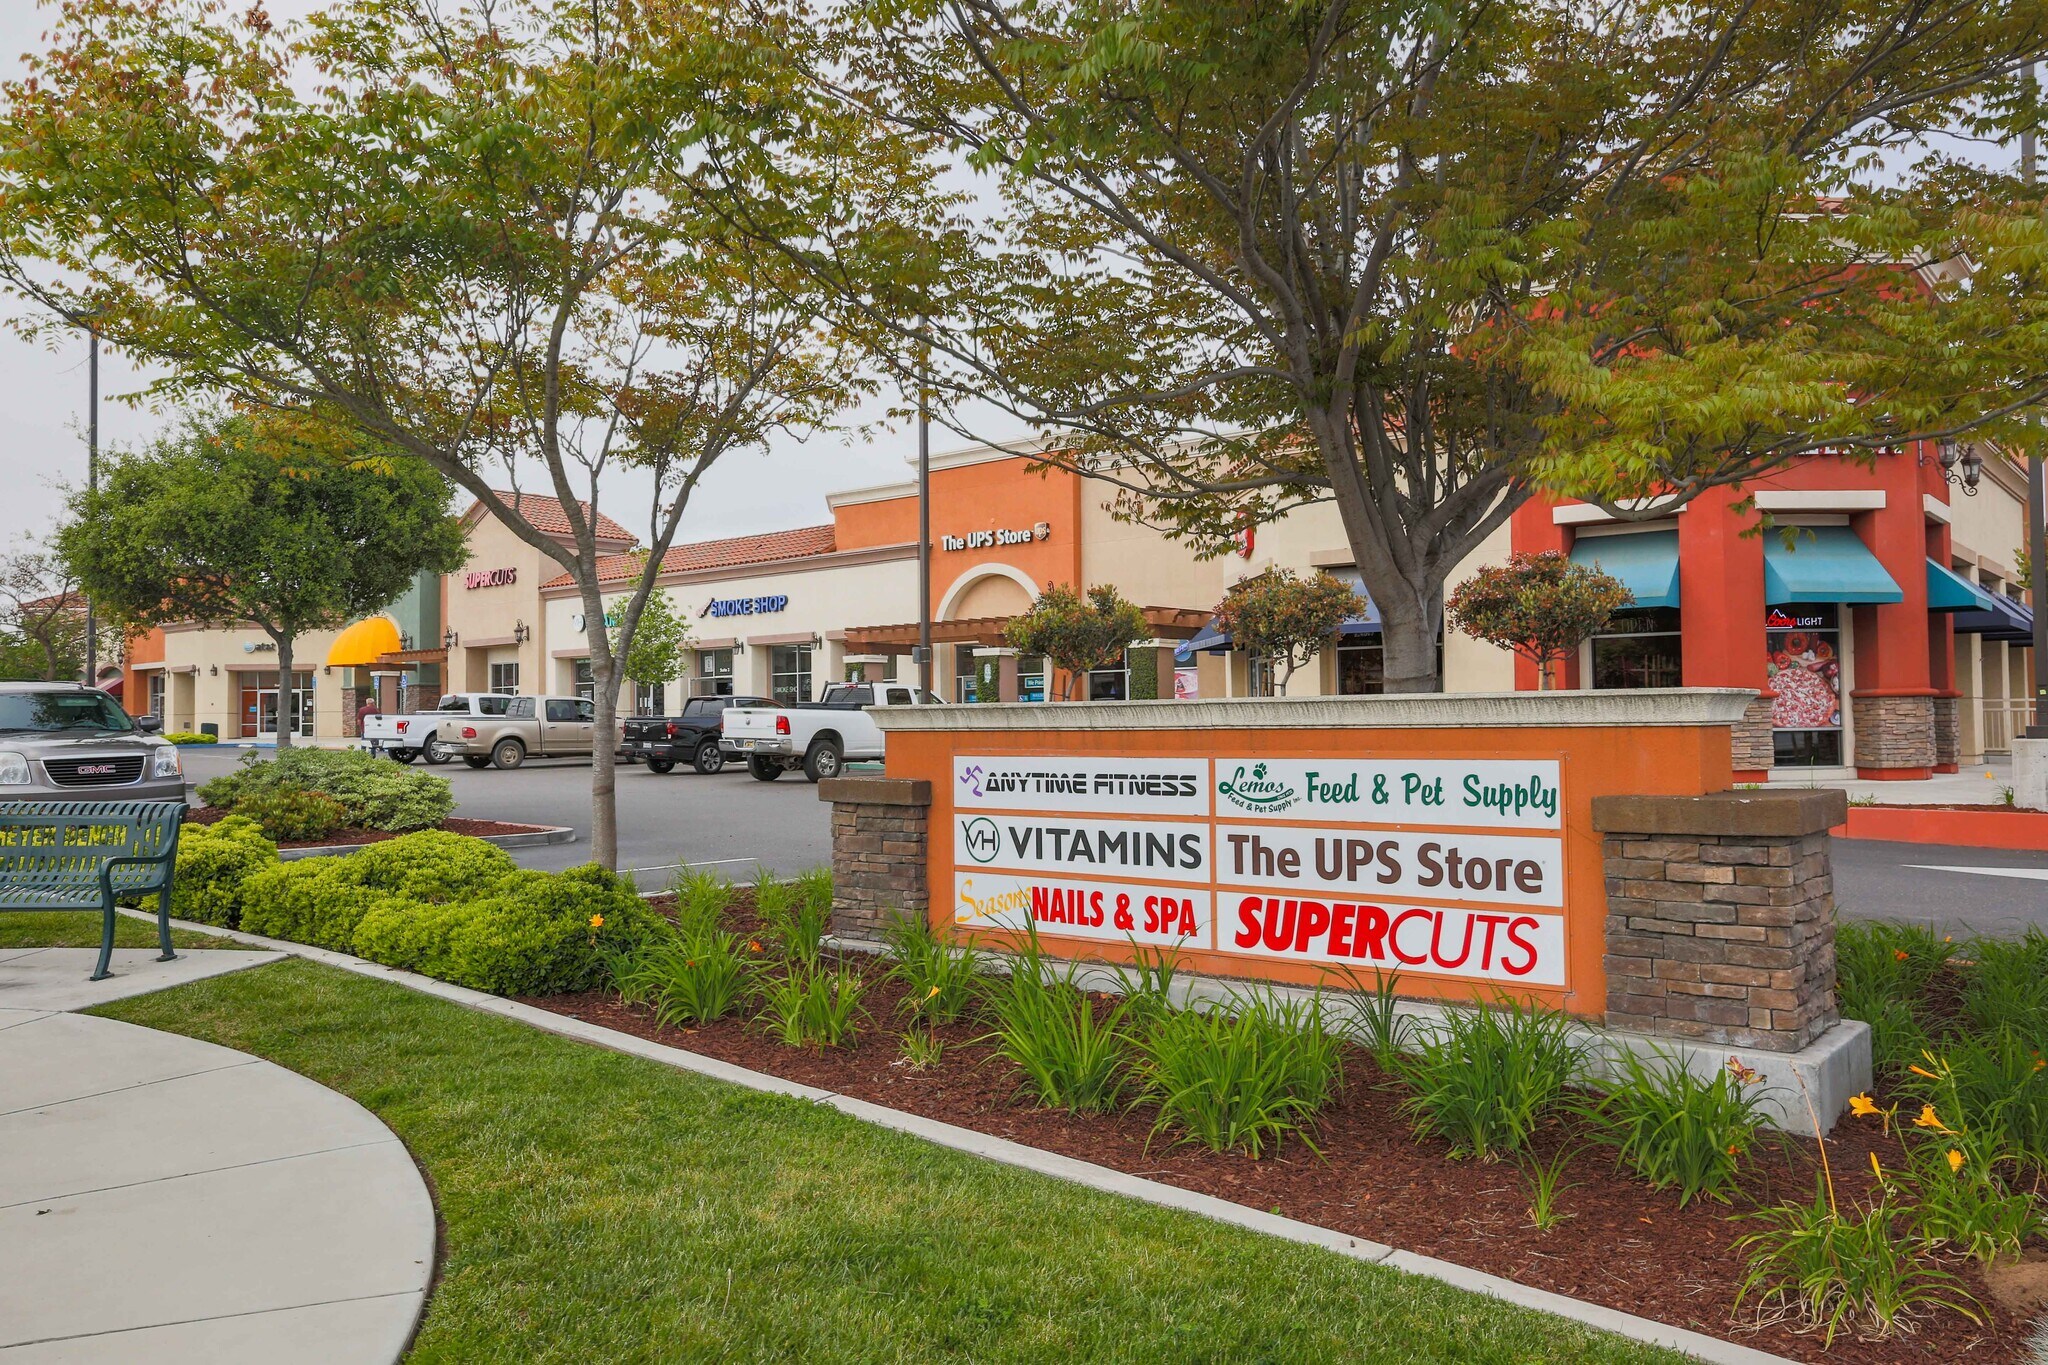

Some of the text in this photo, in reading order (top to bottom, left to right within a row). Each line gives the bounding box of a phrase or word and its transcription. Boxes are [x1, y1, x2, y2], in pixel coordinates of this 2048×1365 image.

[941, 528, 1032, 551] The UPS Store
[711, 595, 788, 617] SMOKE SHOP
[1768, 613, 1823, 626] Coors LIGHT
[78, 765, 116, 774] GMC
[1218, 766, 1285, 797] Lemos
[985, 772, 1197, 797] ANYTIME FITNESS
[1305, 772, 1557, 818] Feed & Pet Supply
[1228, 792, 1245, 807] Feed
[1246, 803, 1253, 811] &
[1254, 804, 1267, 813] Pet
[1268, 799, 1292, 813] Supply
[64, 825, 128, 847] BENCH
[1008, 826, 1202, 870] VITAMINS
[1227, 834, 1544, 894] The UPS Store
[956, 879, 1198, 937] Seasons NAILS & SPA
[1234, 896, 1541, 976] SUPERCUTS
